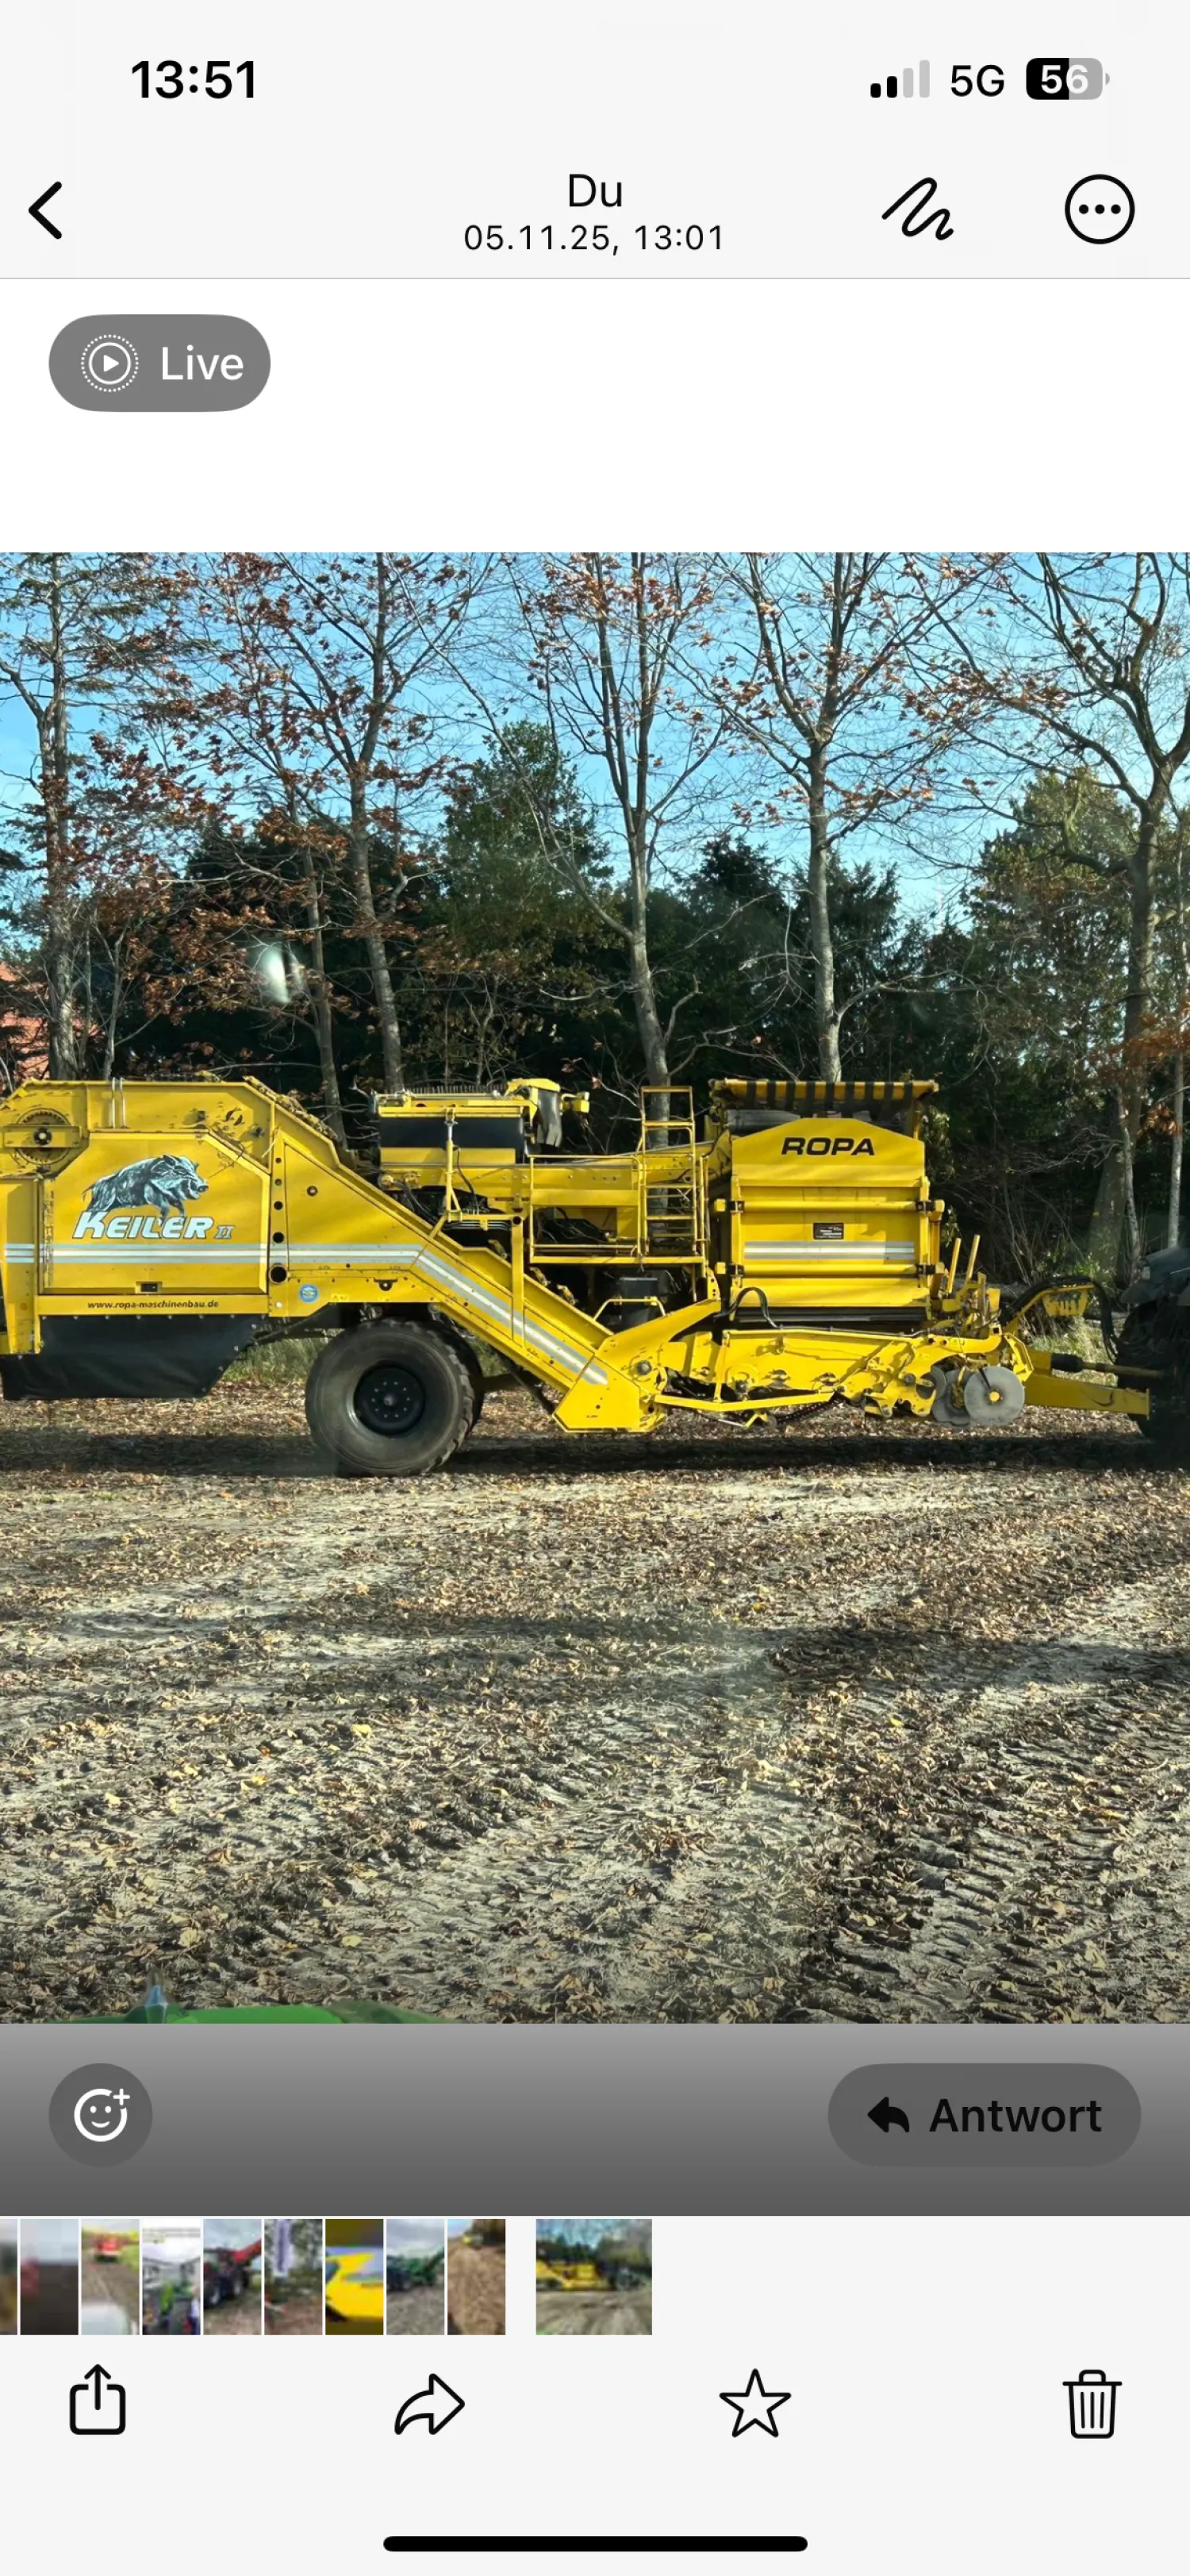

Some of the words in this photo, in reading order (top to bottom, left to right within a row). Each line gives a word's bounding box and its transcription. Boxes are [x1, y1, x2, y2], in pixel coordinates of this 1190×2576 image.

[132, 60, 254, 99] 13:51
[950, 64, 1005, 98] 5G
[1041, 64, 1088, 94] 56
[568, 173, 623, 208] Du
[464, 224, 619, 256] 05.11.25,
[635, 224, 721, 251] 13:01
[161, 344, 244, 382] Live
[781, 1137, 875, 1156] ROPA
[72, 1211, 214, 1240] KEILER
[214, 1225, 236, 1240] II
[87, 1299, 219, 1310] www.ropa-maschinenbau.de
[929, 2097, 1103, 2134] Antwort
